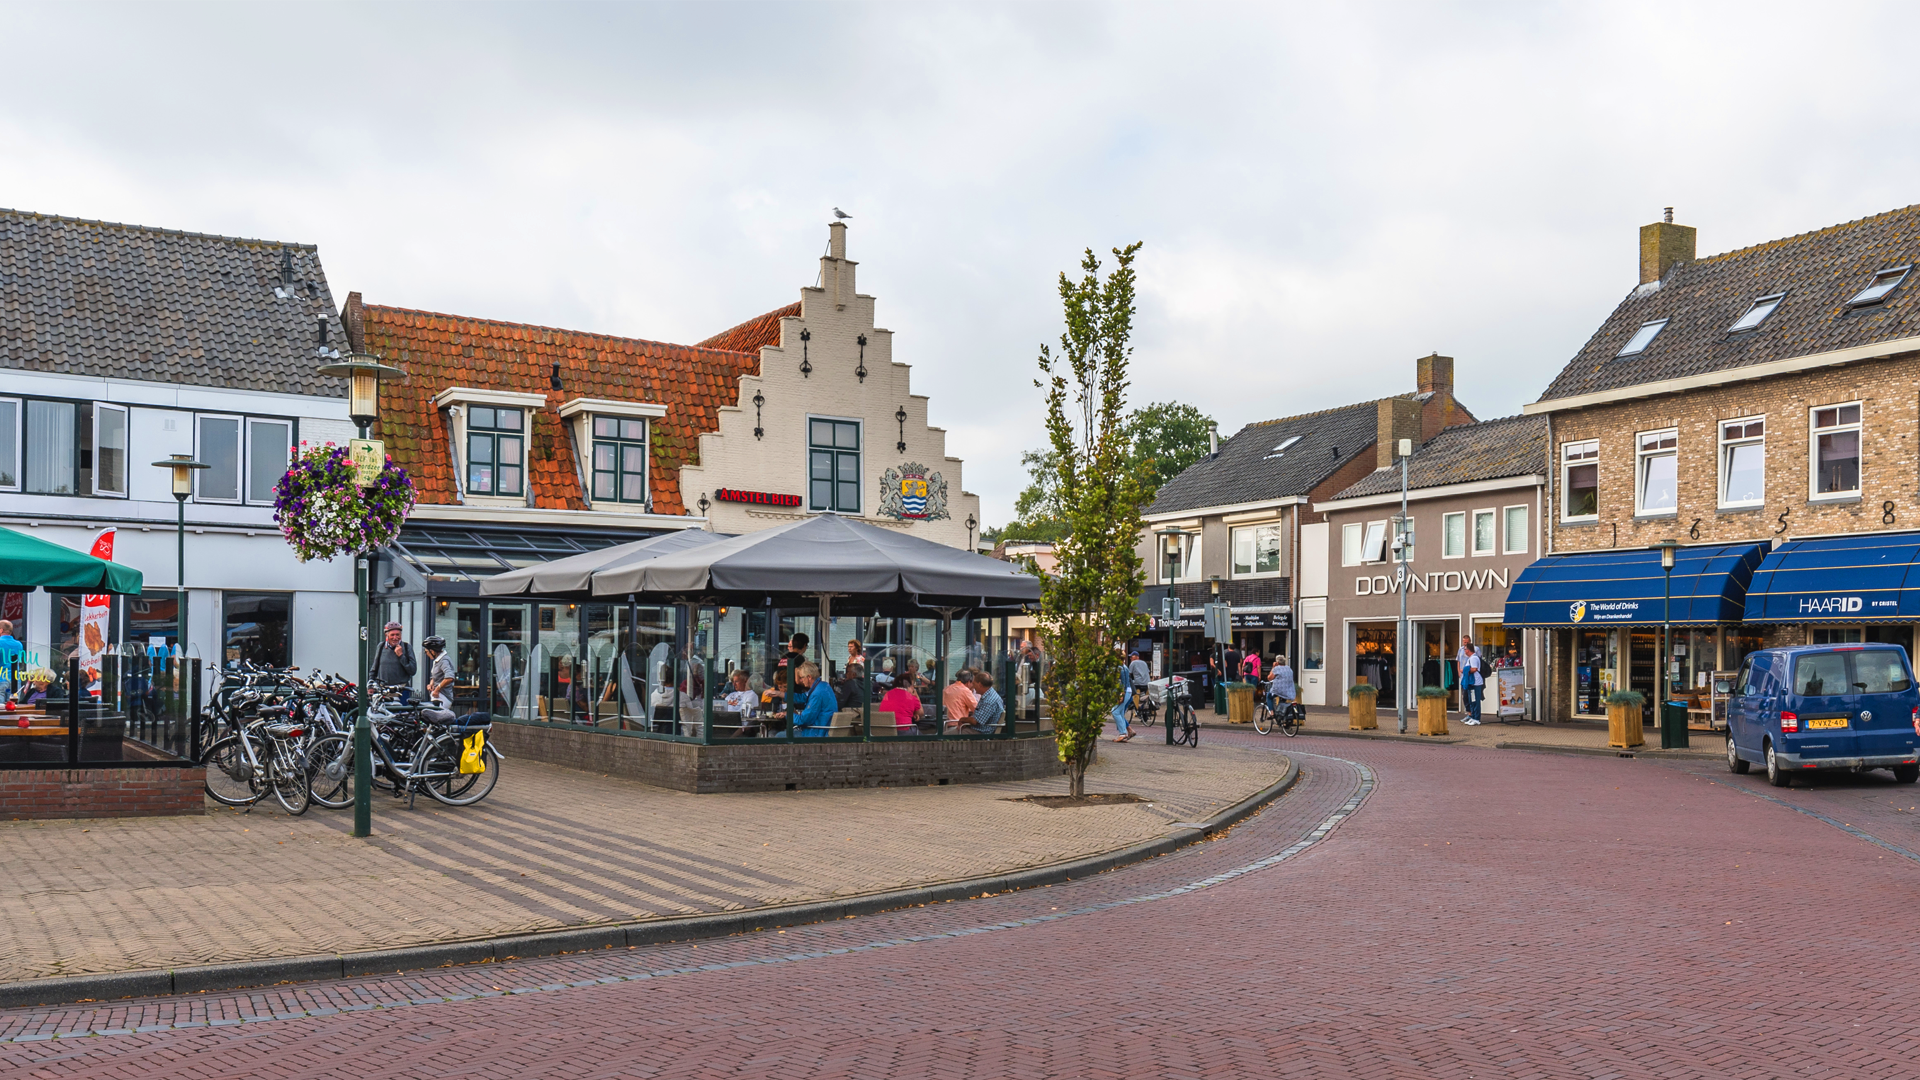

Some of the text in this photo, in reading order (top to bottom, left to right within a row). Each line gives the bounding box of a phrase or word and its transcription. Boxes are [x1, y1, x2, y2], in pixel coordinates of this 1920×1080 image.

[720, 488, 800, 507] AMSTEL BIER
[1690, 518, 1701, 540] 6
[1775, 507, 1790, 534] 5
[1883, 501, 1895, 524] 8
[1355, 567, 1509, 596] DOWNTOWN
[1398, 570, 1403, 579] 3
[1590, 603, 1600, 611] The
[1616, 602, 1622, 610] of
[1622, 602, 1639, 610] Drinks
[1799, 597, 1863, 613] HAARID
[1811, 719, 1845, 727] 7-VXZ-40
